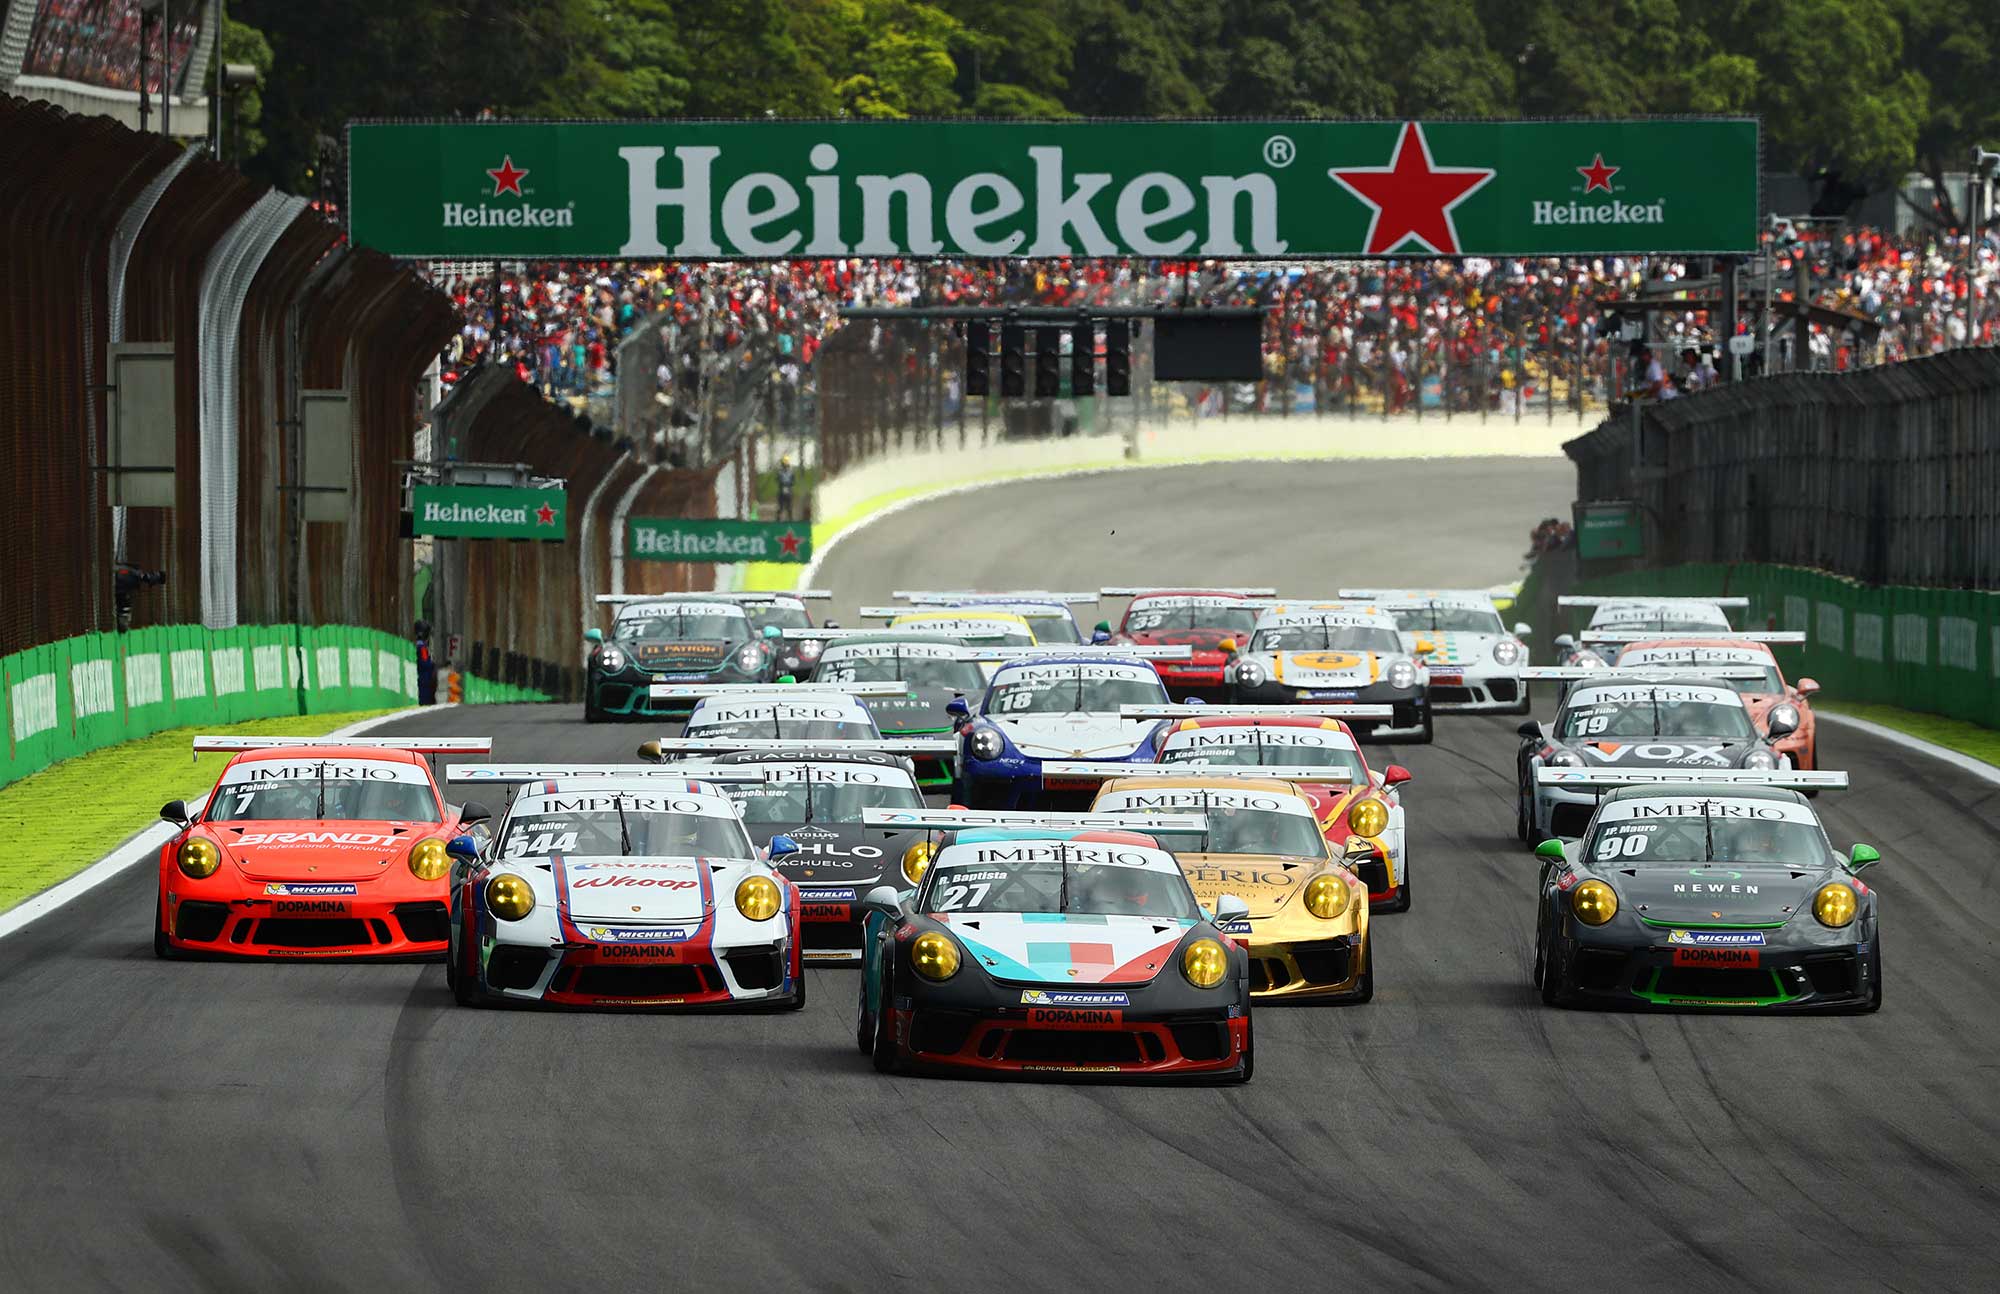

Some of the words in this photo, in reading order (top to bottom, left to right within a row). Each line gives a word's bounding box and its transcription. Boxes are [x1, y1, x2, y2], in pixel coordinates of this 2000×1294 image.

[619, 144, 1288, 255] Heineken
[442, 203, 573, 227] Heineken
[1532, 200, 1663, 224] Heineken
[424, 502, 527, 523] Heineken
[635, 527, 766, 555] Heineken
[1265, 634, 1282, 650] 2
[1000, 692, 1034, 712] 18
[1574, 716, 1610, 737] 19
[737, 752, 886, 763] RIACHUELO
[1583, 743, 1731, 766] VOX
[240, 782, 279, 793] Paludo
[234, 792, 255, 815] 7
[1620, 824, 1658, 834] Mauro
[227, 832, 412, 847] BRANDT
[503, 832, 579, 858] 544
[1597, 834, 1650, 861] 90
[572, 875, 698, 891] Whoop
[952, 871, 1008, 883] Baptista
[940, 882, 992, 912] 27
[1673, 884, 1759, 894] NEWEN
[276, 900, 346, 913] DOPAMINA
[801, 905, 844, 917] AMINA
[618, 930, 684, 938] MICHELIN
[602, 945, 676, 958] DOPAMINA
[1681, 949, 1752, 962] DOPAMINA
[1053, 995, 1125, 1003] MICHELIN
[1035, 1010, 1114, 1024] DOPAMINA
